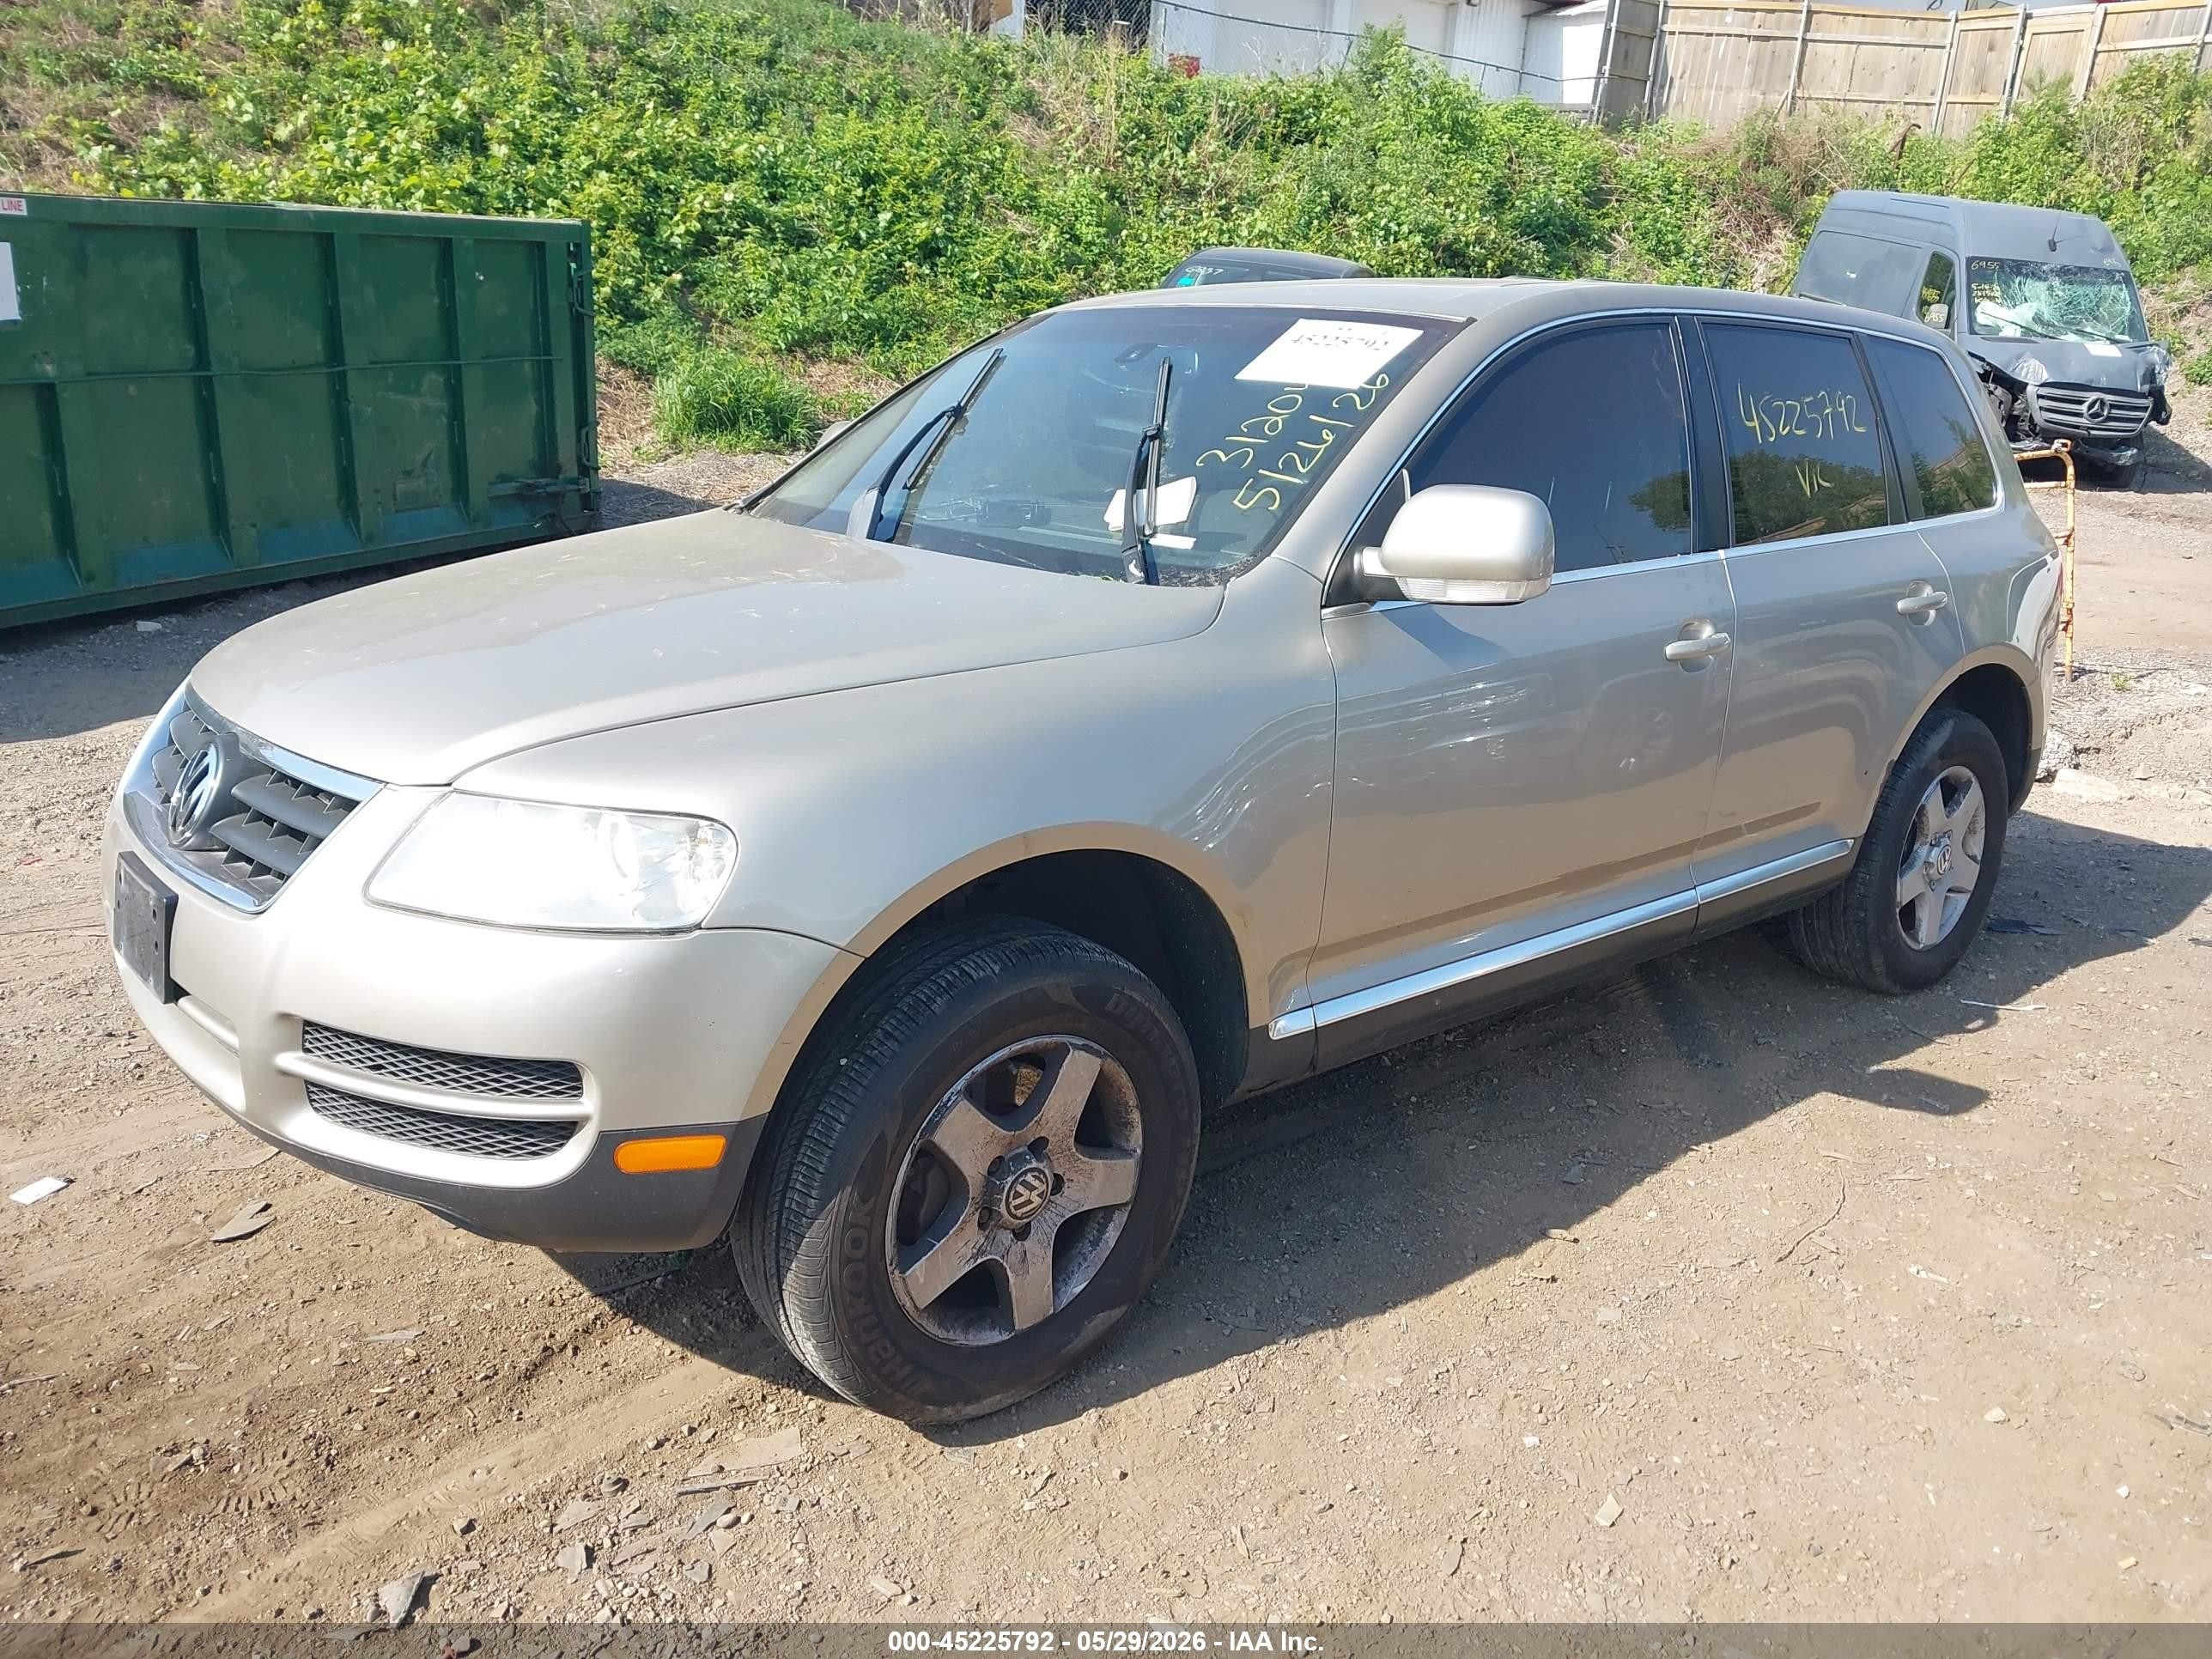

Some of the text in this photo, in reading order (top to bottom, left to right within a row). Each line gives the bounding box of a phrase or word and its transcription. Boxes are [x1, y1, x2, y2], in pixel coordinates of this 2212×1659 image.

[2, 199, 23, 211] LINE
[1972, 260, 2000, 270] 6955
[1738, 379, 1868, 444] 45225792
